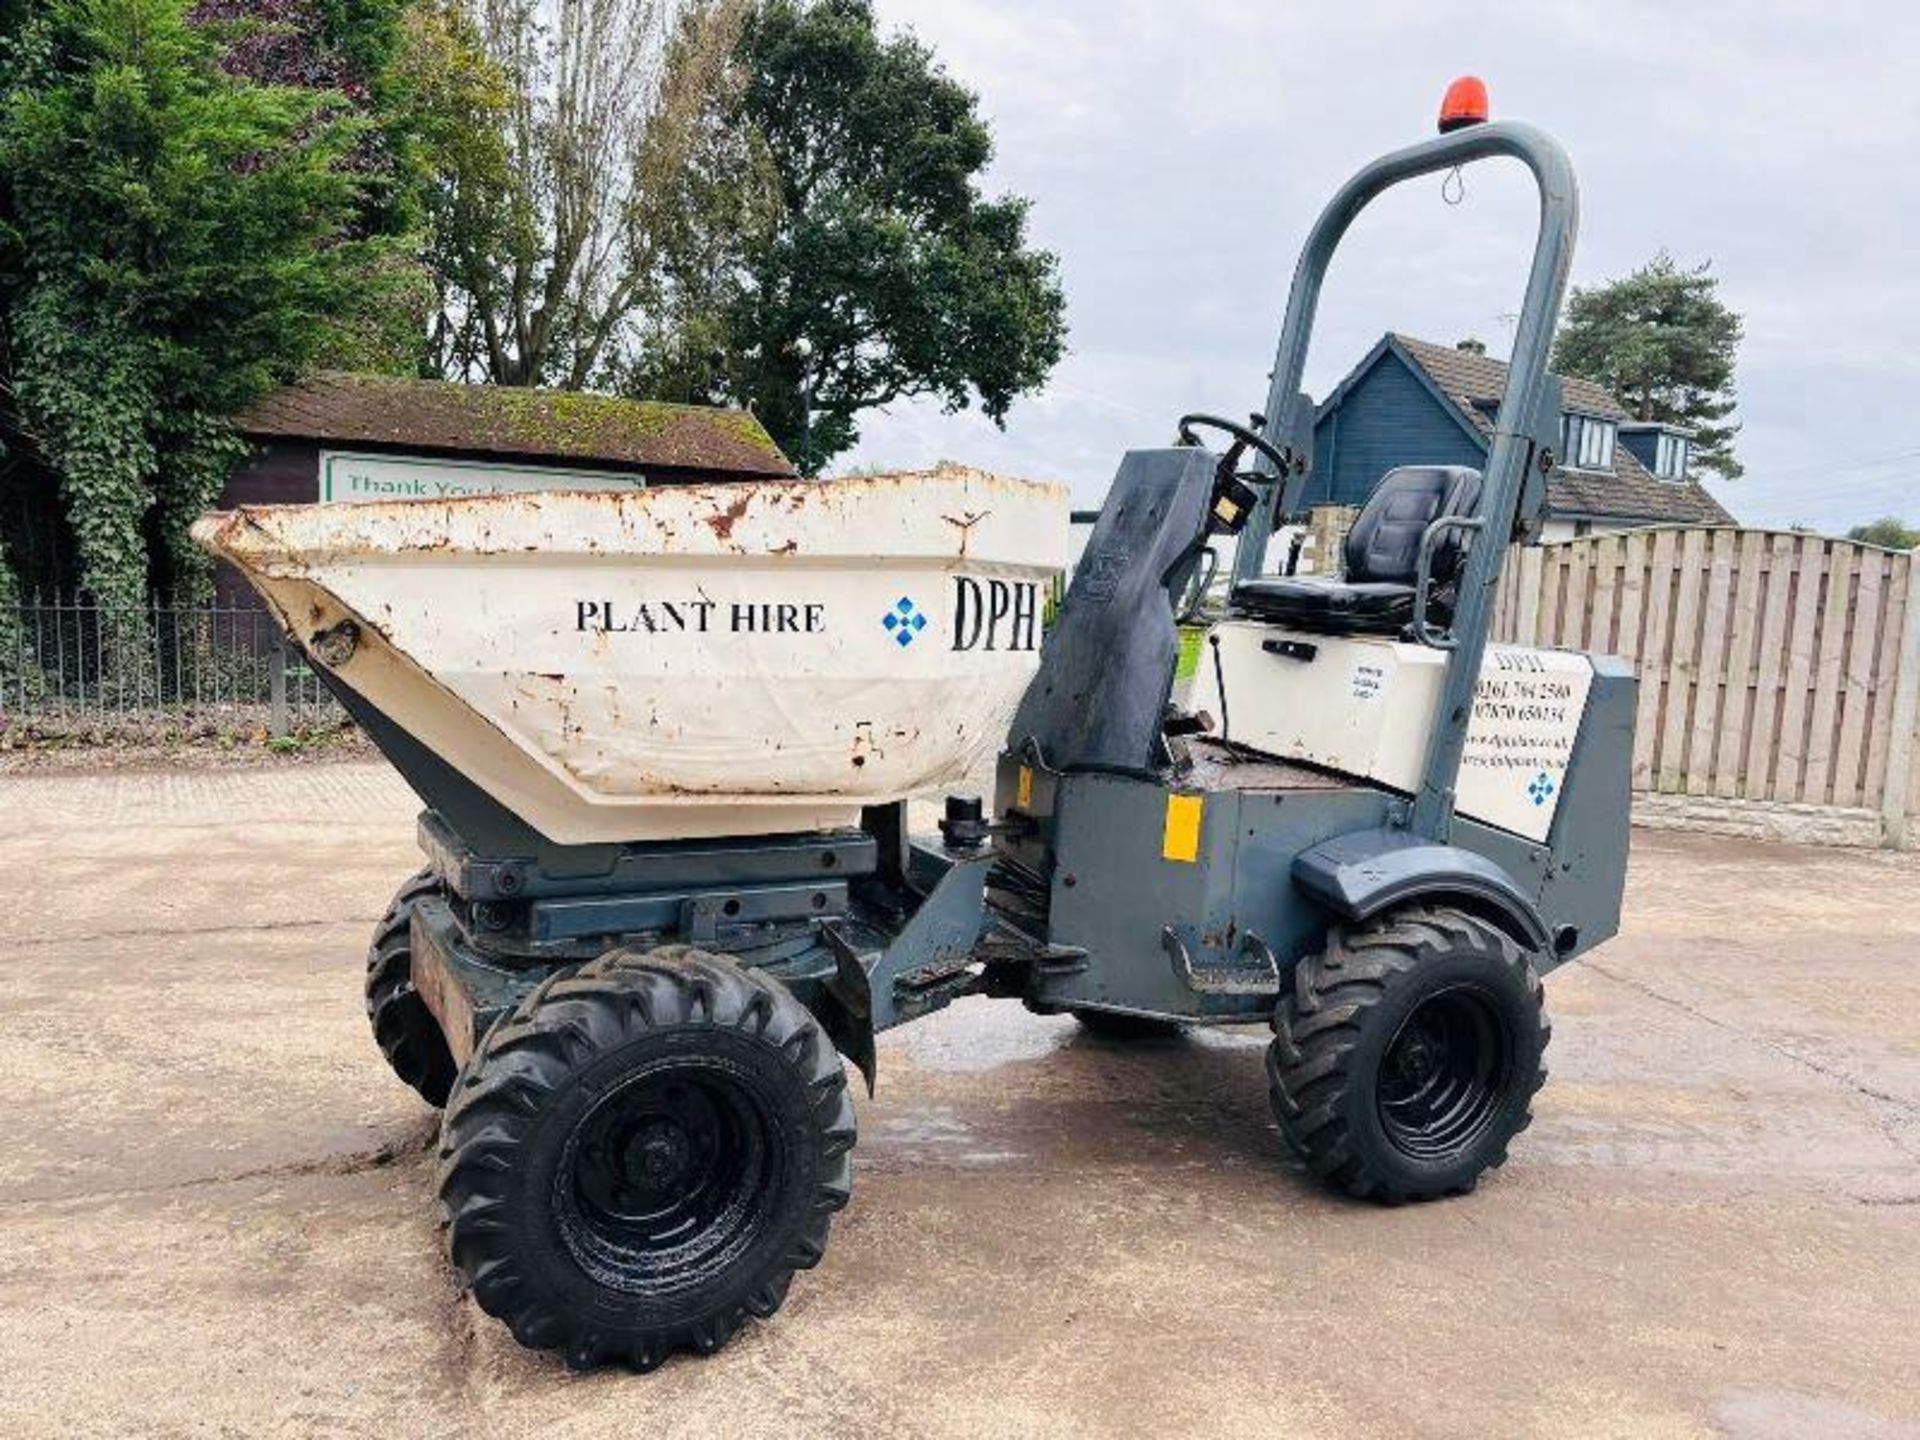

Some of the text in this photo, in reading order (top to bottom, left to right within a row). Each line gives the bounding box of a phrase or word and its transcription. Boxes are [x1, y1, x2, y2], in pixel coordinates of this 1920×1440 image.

[348, 473, 427, 496] Thank
[575, 600, 825, 634] PLANT HIRE
[951, 575, 1038, 652] DPH
